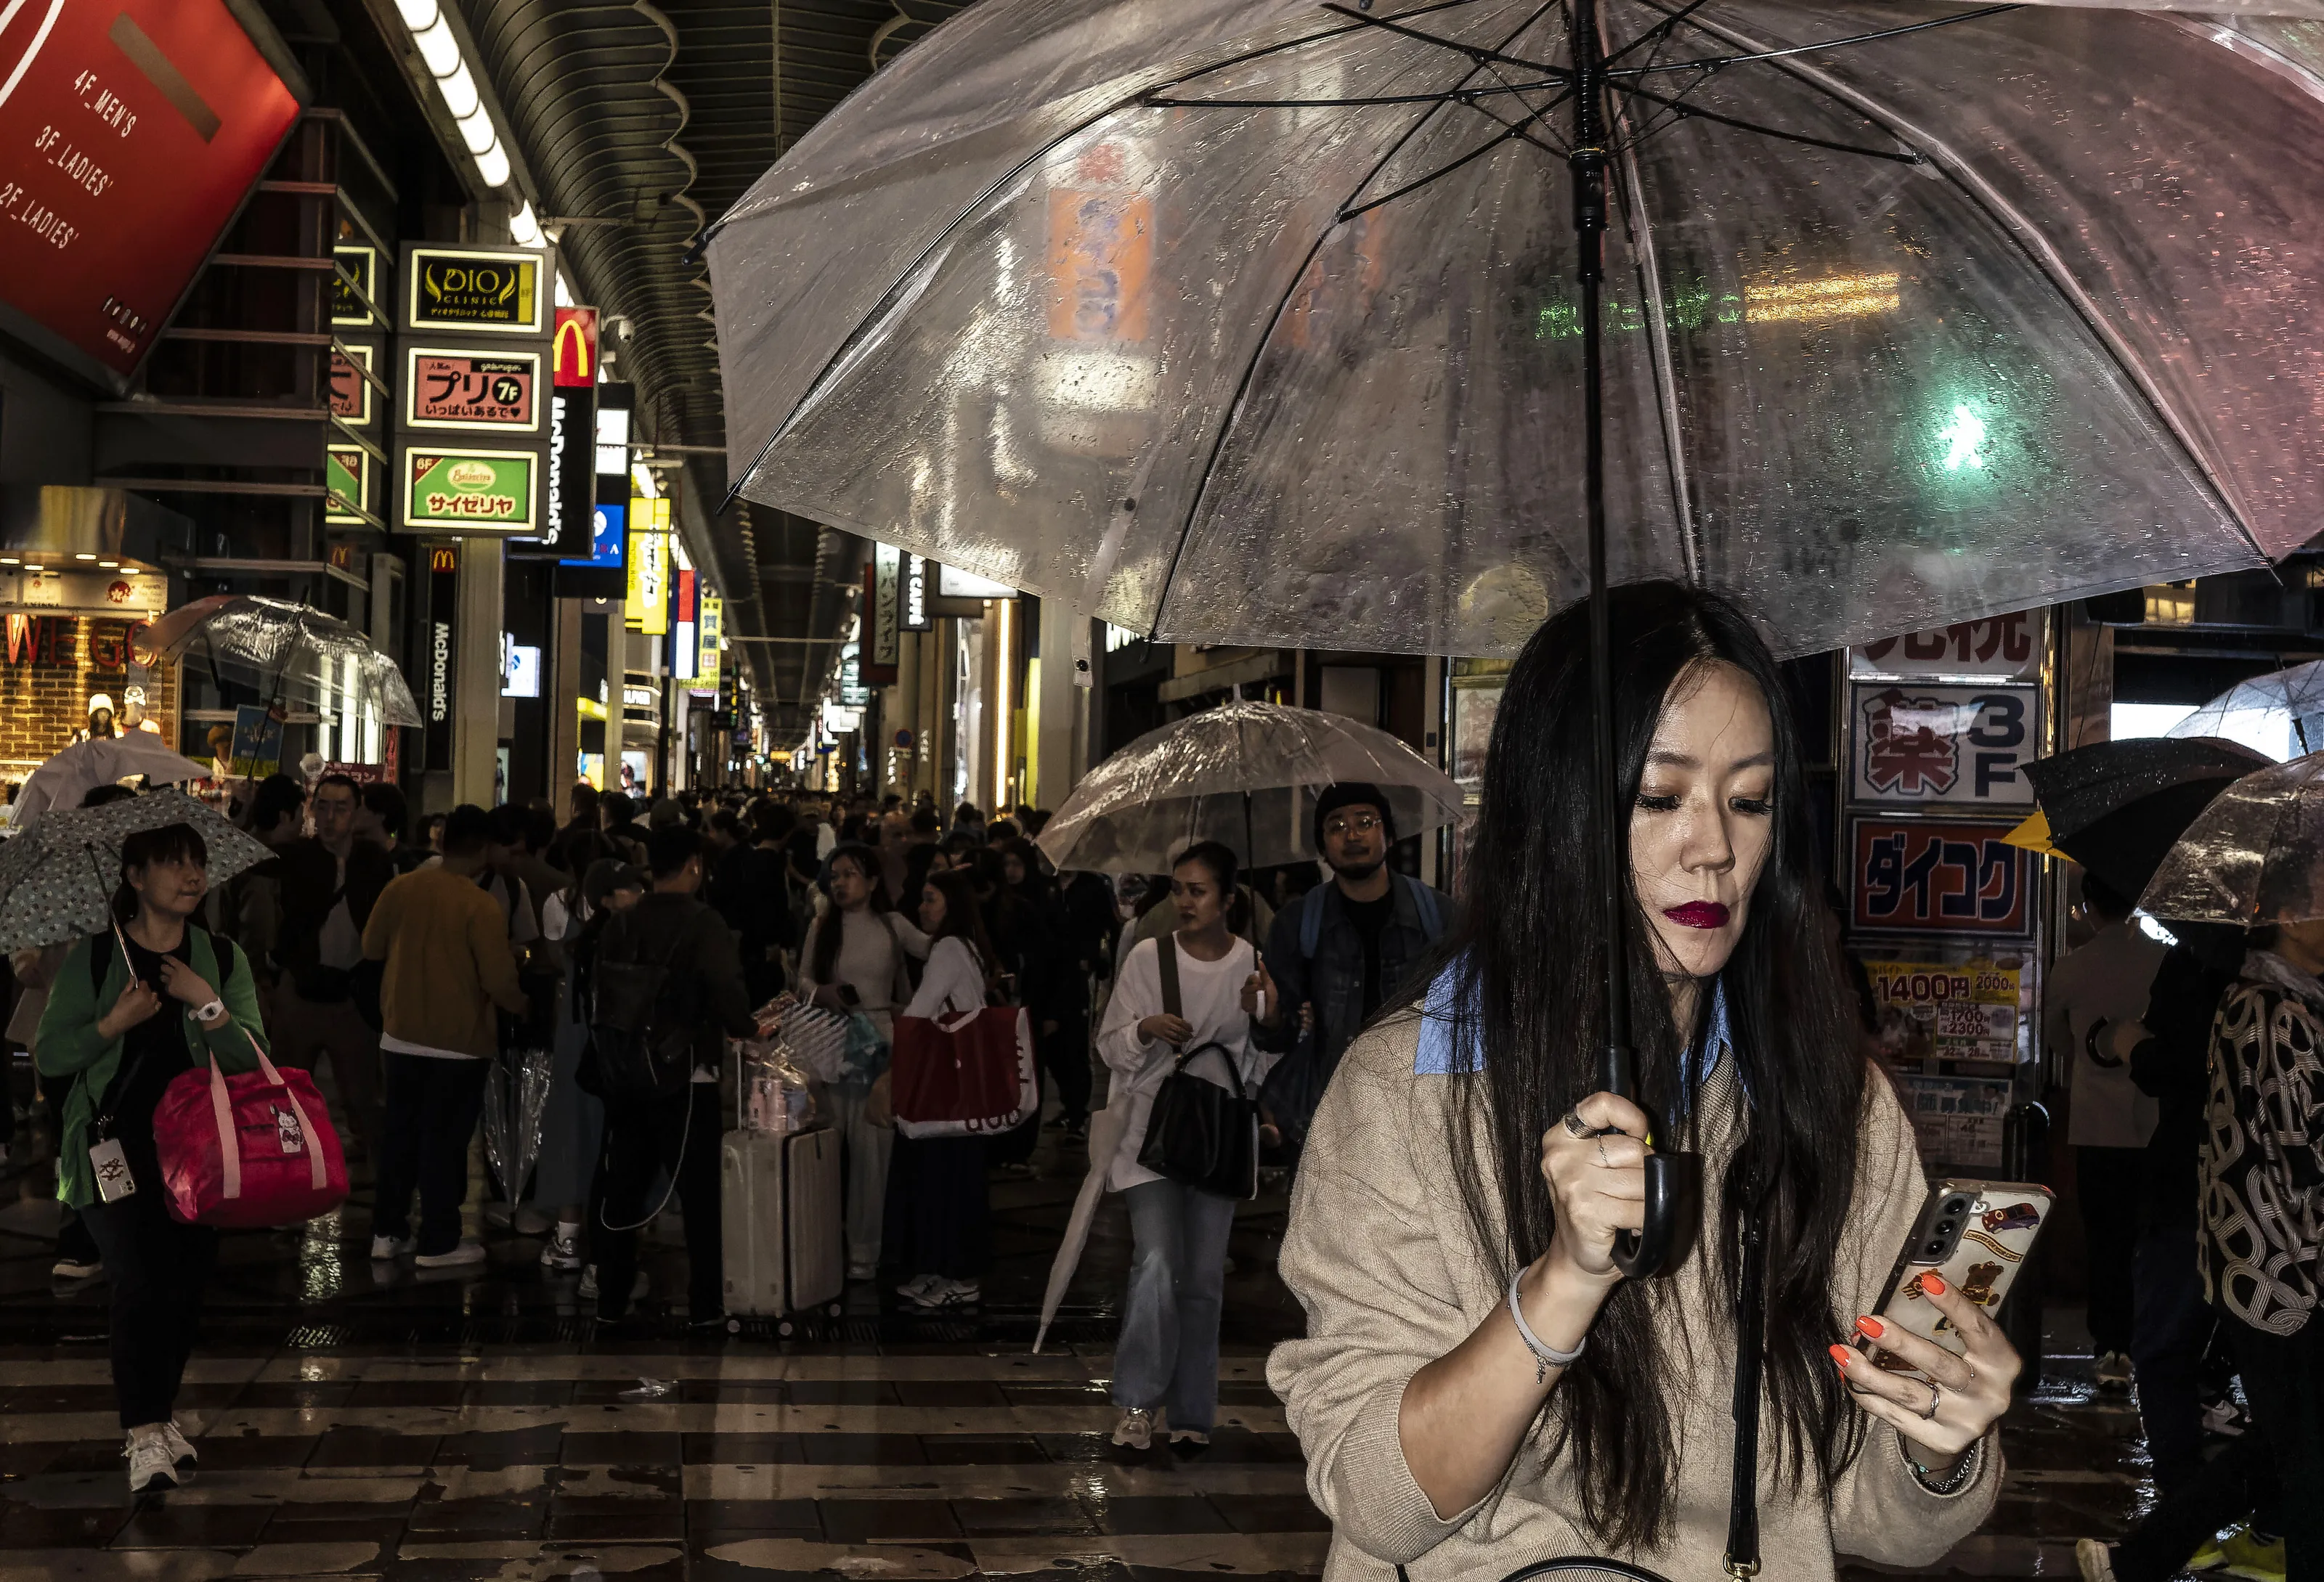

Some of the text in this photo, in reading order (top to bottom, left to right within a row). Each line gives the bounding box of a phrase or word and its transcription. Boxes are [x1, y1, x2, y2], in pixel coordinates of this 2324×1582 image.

[443, 268, 500, 293] DIO
[427, 371, 519, 404] プリ 7F
[425, 404, 508, 417] いっぱいあるで
[416, 457, 433, 470] 6F
[428, 495, 514, 515] サイゼリヤ
[431, 622, 450, 722] McDonald's
[1865, 831, 2018, 921] ダイコク
